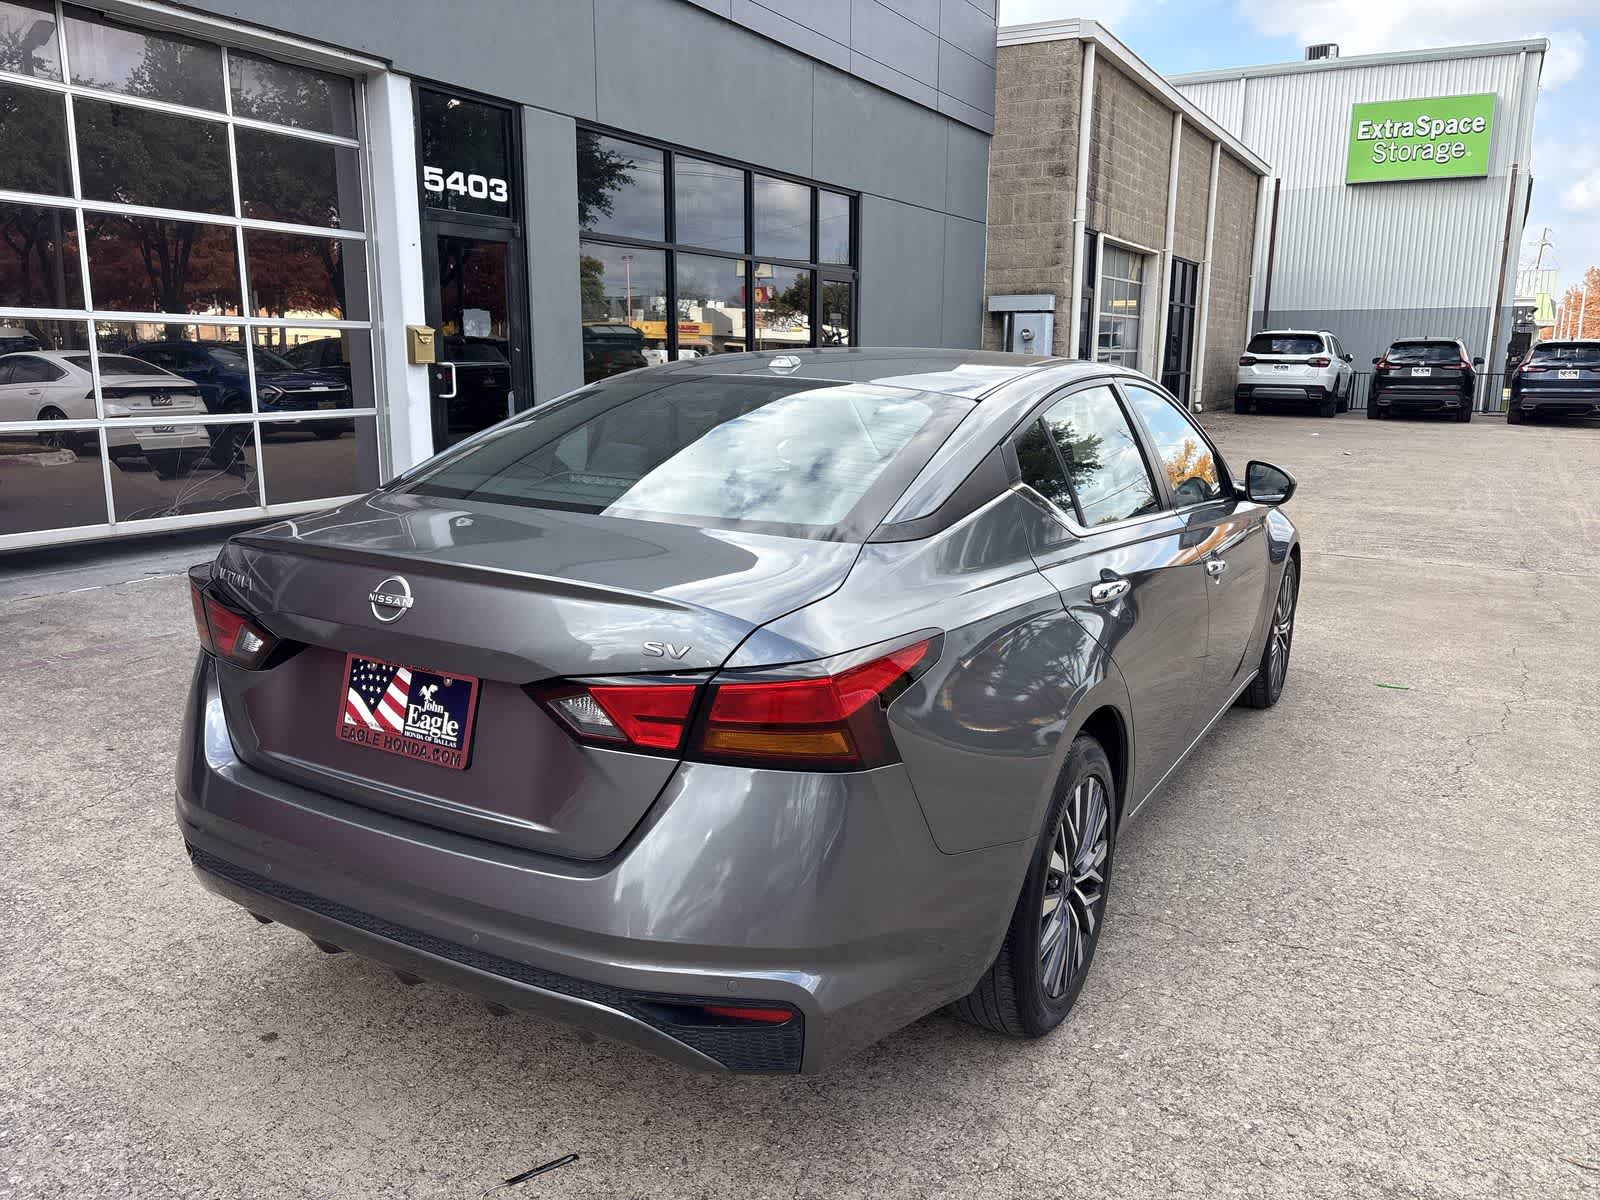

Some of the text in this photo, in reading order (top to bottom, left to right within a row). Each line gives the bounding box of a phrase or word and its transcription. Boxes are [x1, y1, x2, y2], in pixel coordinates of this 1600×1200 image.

[1372, 141, 1465, 164] Storage
[423, 165, 508, 203] 5403
[369, 592, 414, 609] NISSAN
[642, 641, 692, 660] SV
[421, 700, 444, 714] John
[405, 703, 459, 738] Eagle
[340, 725, 462, 767] EAGLE HONDA.COM
[404, 730, 424, 741] HONDA
[434, 737, 457, 748] DALLAS
